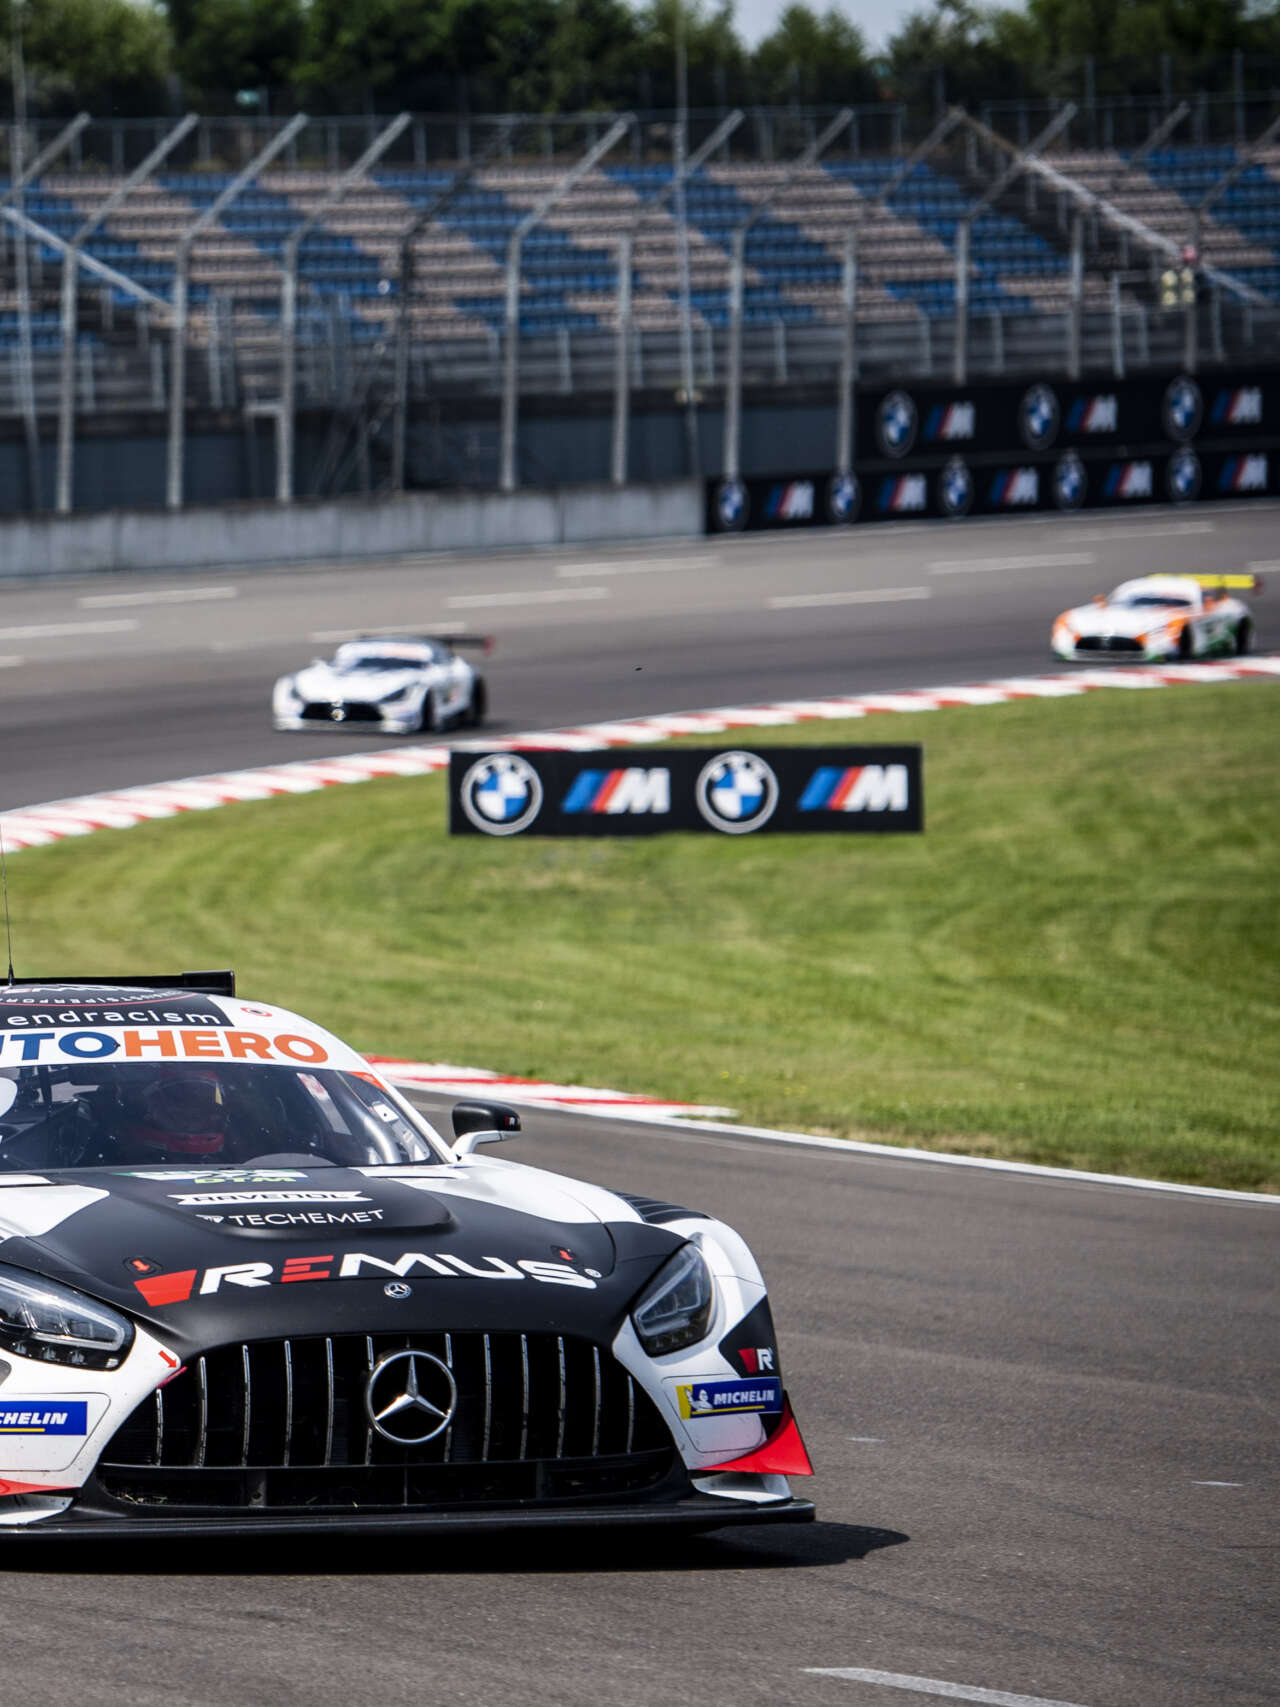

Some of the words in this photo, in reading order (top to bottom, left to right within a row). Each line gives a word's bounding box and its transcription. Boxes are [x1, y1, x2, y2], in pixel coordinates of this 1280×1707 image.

[607, 768, 670, 814] M
[843, 764, 908, 812] M
[229, 1209, 385, 1226] TECHEMET
[199, 1253, 598, 1296] REMUS
[713, 1389, 775, 1405] MICHELIN
